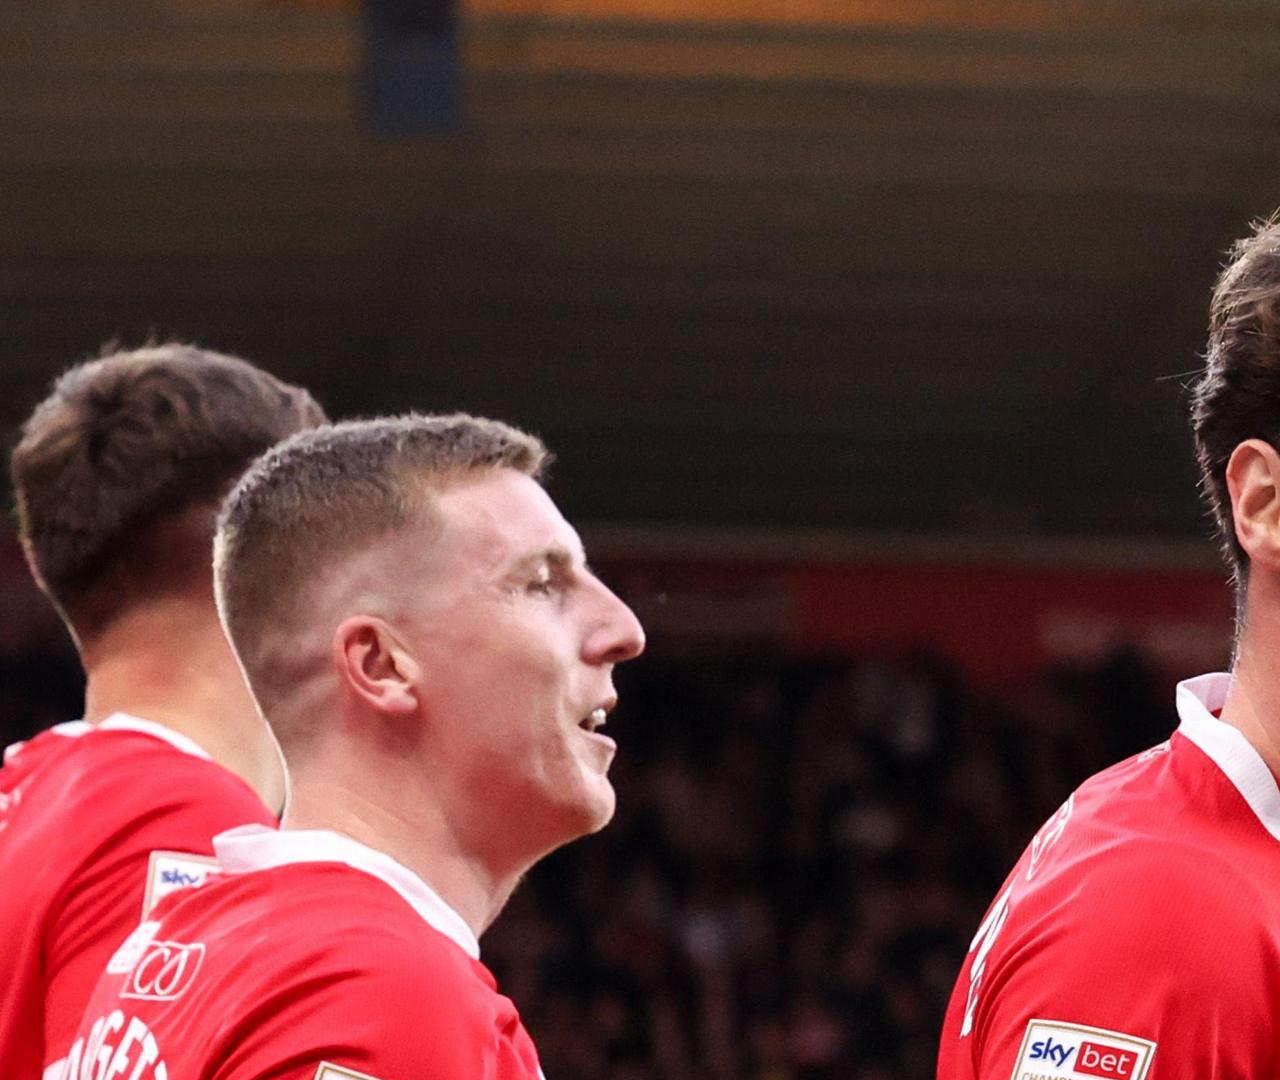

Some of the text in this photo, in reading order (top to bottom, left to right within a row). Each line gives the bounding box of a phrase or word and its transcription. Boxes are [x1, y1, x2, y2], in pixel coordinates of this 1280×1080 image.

[133, 946, 190, 996] CO
[1029, 1037, 1131, 1075] sky bet
